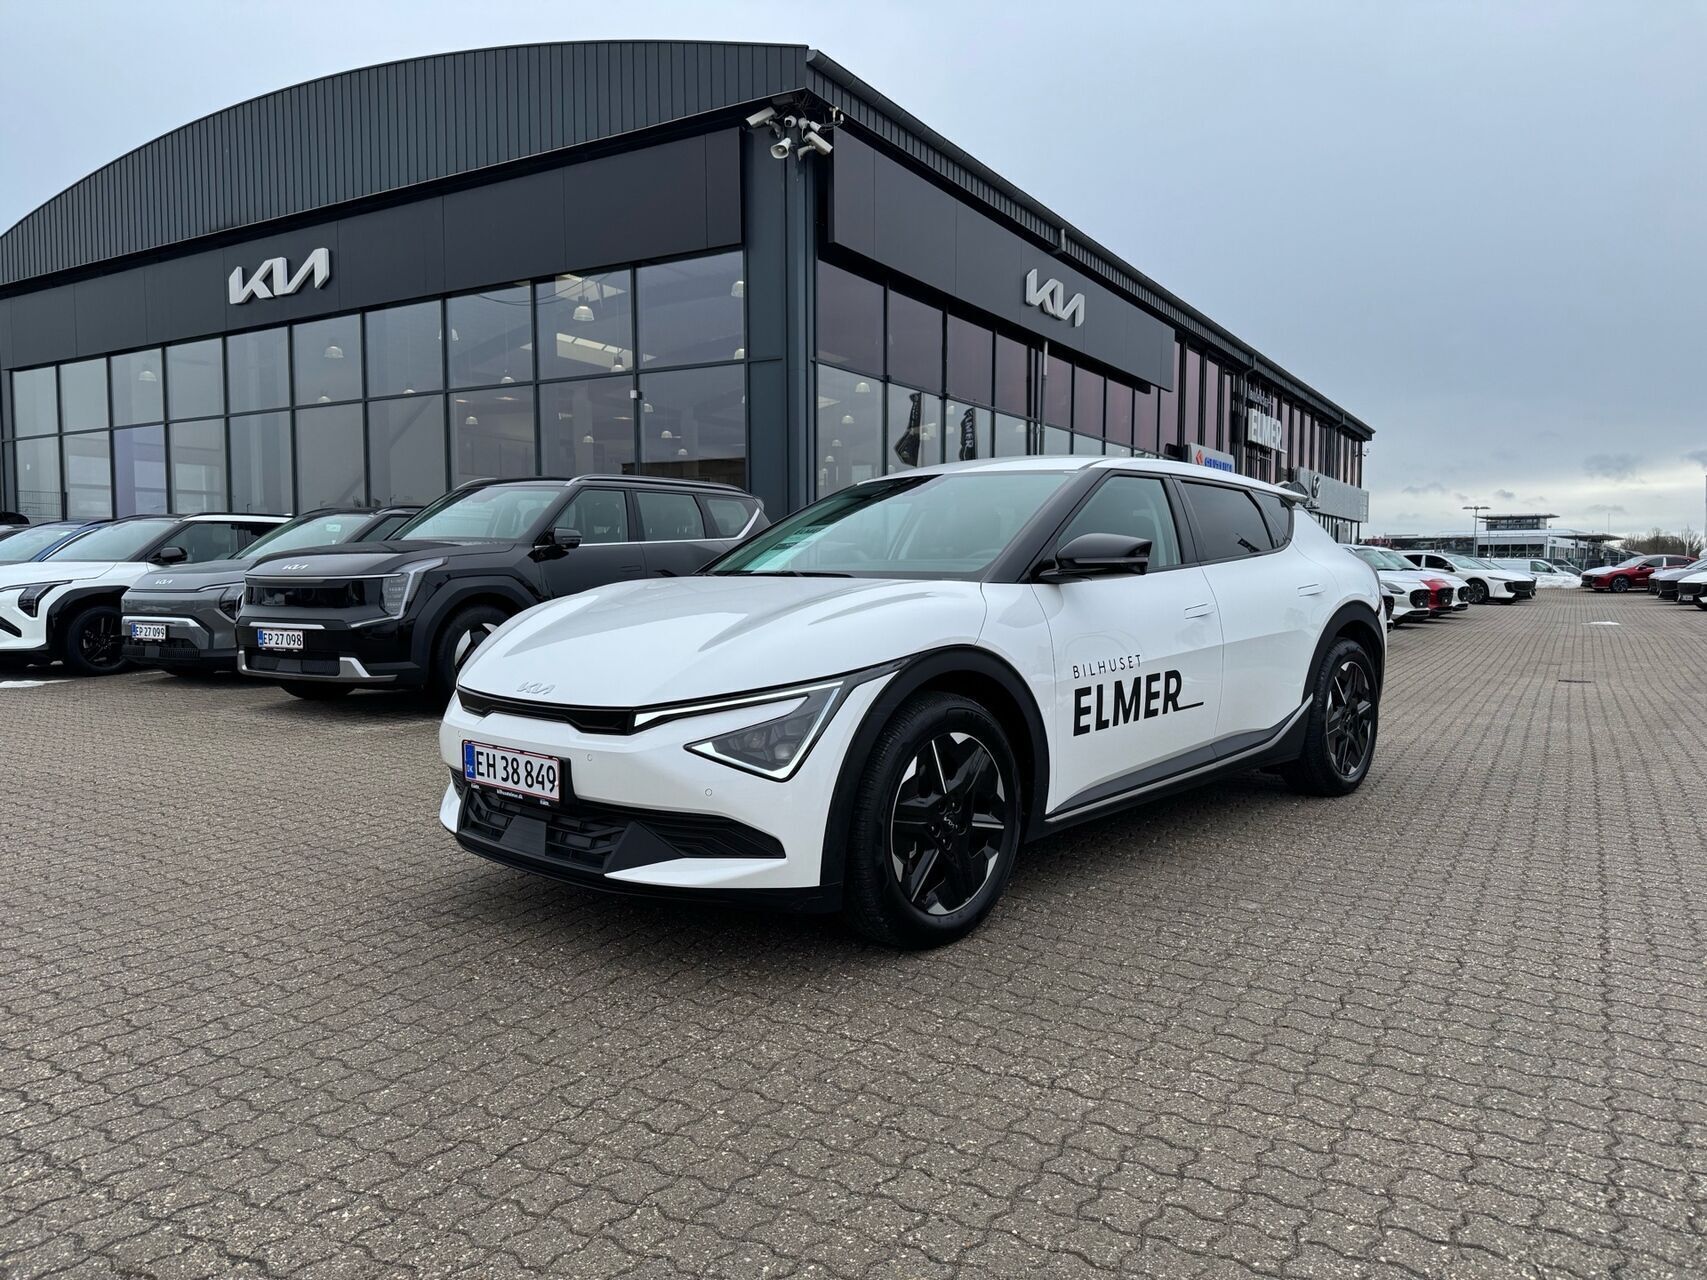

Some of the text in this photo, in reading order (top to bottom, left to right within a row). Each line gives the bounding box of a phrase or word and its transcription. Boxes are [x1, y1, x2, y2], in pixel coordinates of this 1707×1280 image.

[228, 247, 330, 305] KIA
[1025, 268, 1085, 328] KIA
[144, 626, 152, 637] 27
[152, 627, 165, 638] 099
[263, 632, 303, 646] EP 27 098
[1072, 654, 1142, 679] BILHUSET
[516, 681, 556, 695] KIA
[1073, 669, 1204, 736] ELMER
[476, 750, 557, 793] EH 38 849
